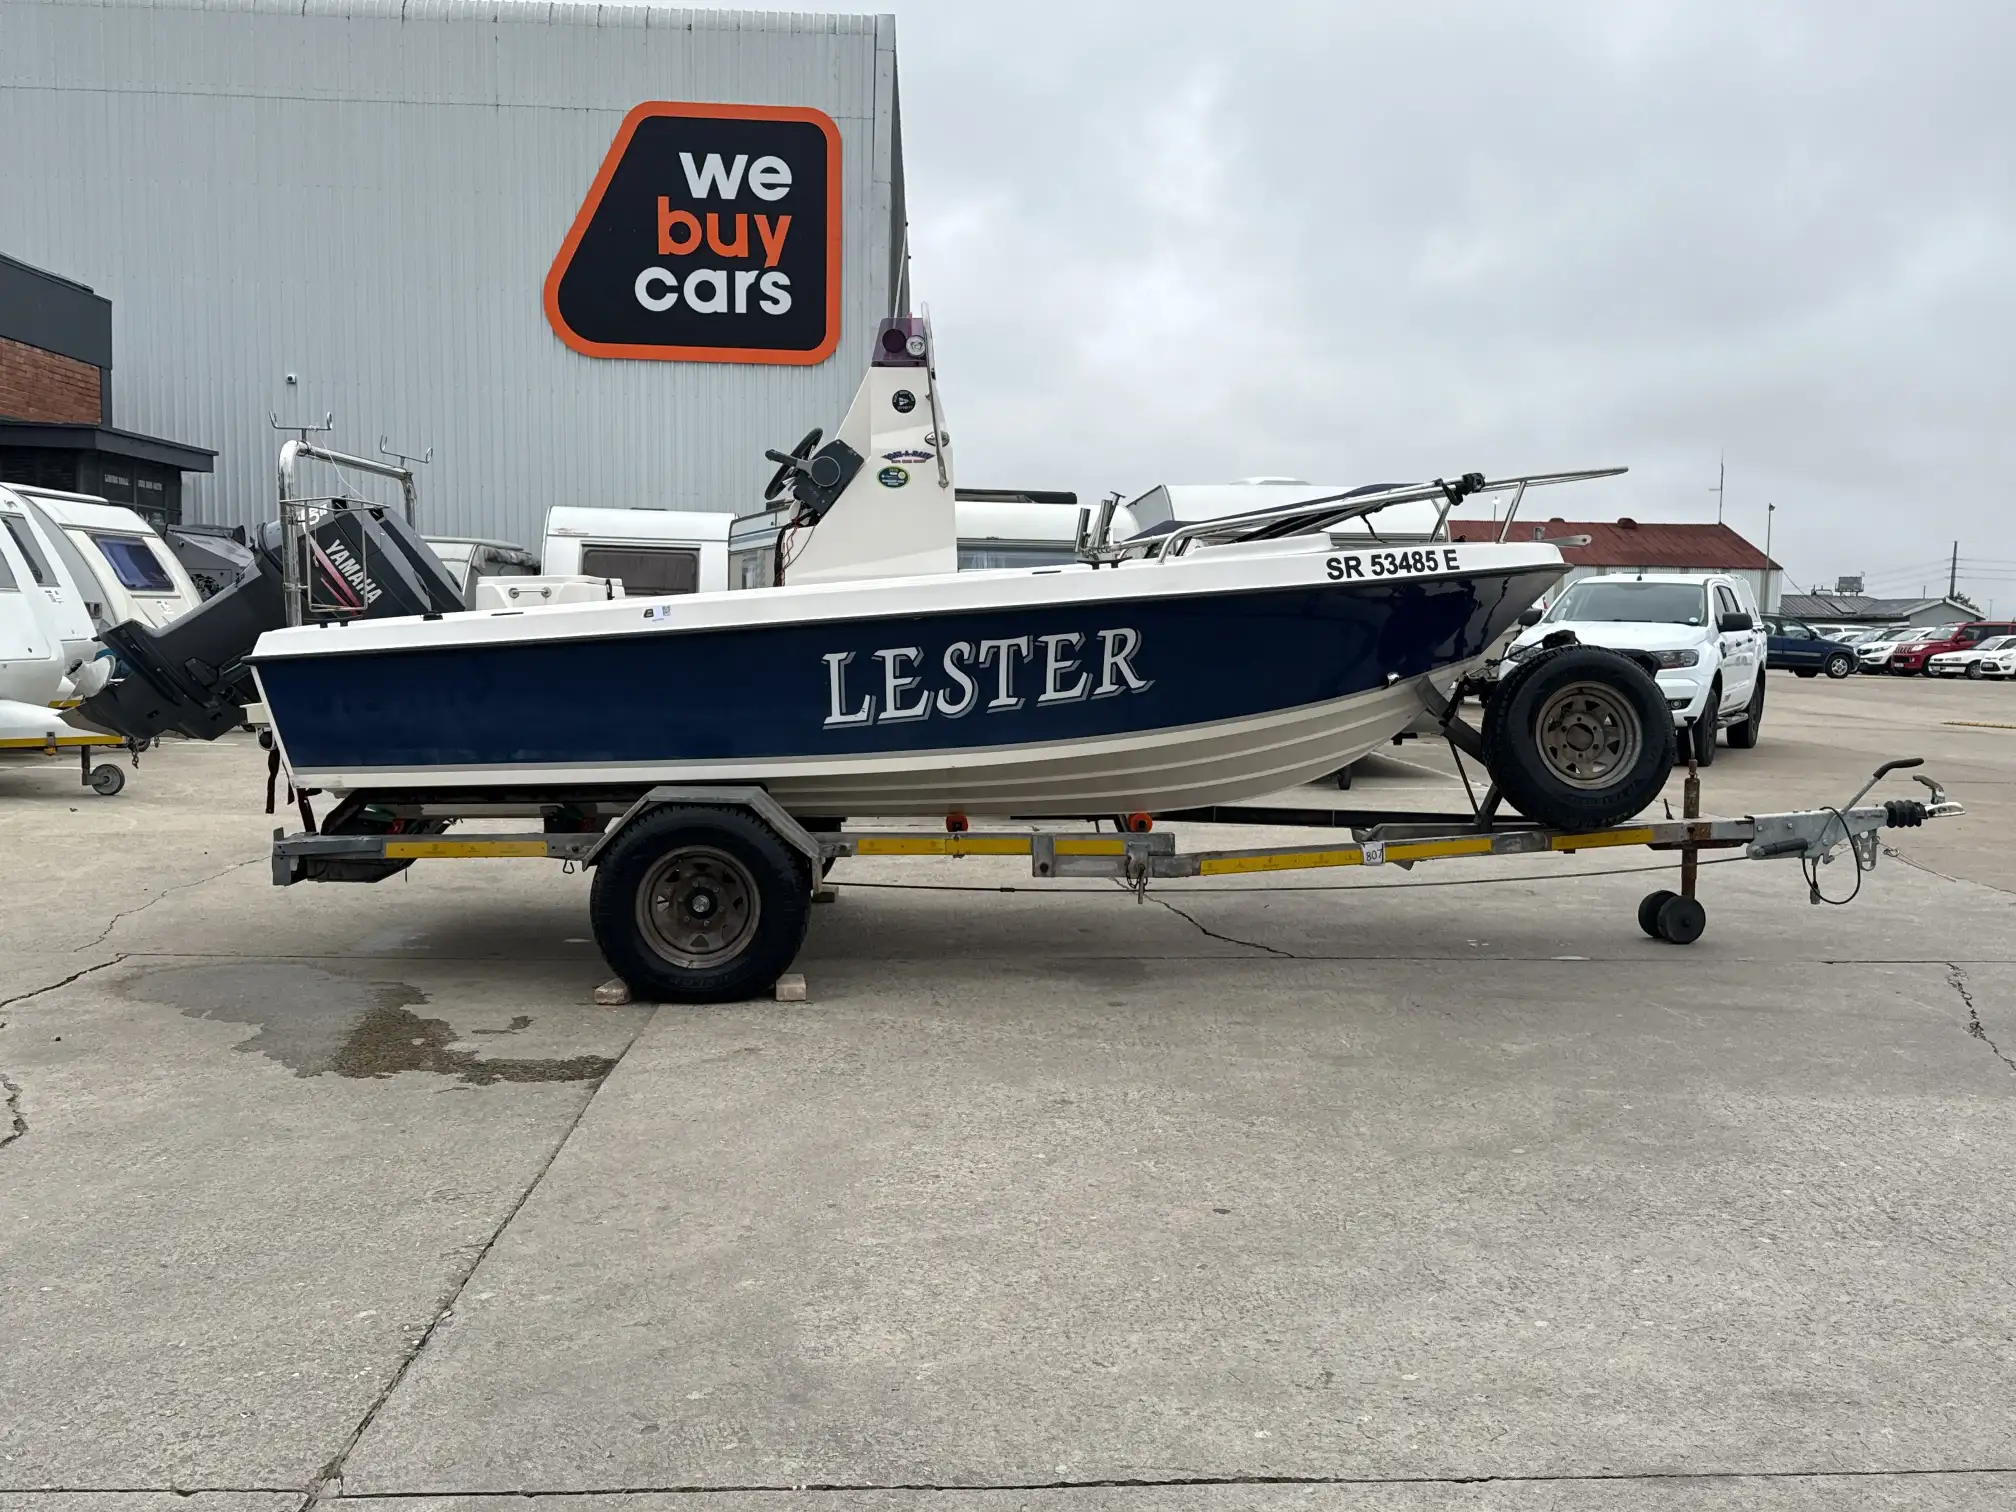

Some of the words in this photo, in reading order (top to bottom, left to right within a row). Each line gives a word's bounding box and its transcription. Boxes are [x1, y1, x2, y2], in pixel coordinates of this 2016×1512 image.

[679, 152, 793, 201] we
[657, 196, 792, 268] buy
[634, 266, 792, 315] cars
[325, 539, 383, 604] YAMAHA
[1326, 556, 1365, 580] SR
[1370, 551, 1439, 576] 53485
[1443, 549, 1461, 571] E
[821, 627, 1156, 730] LESTER
